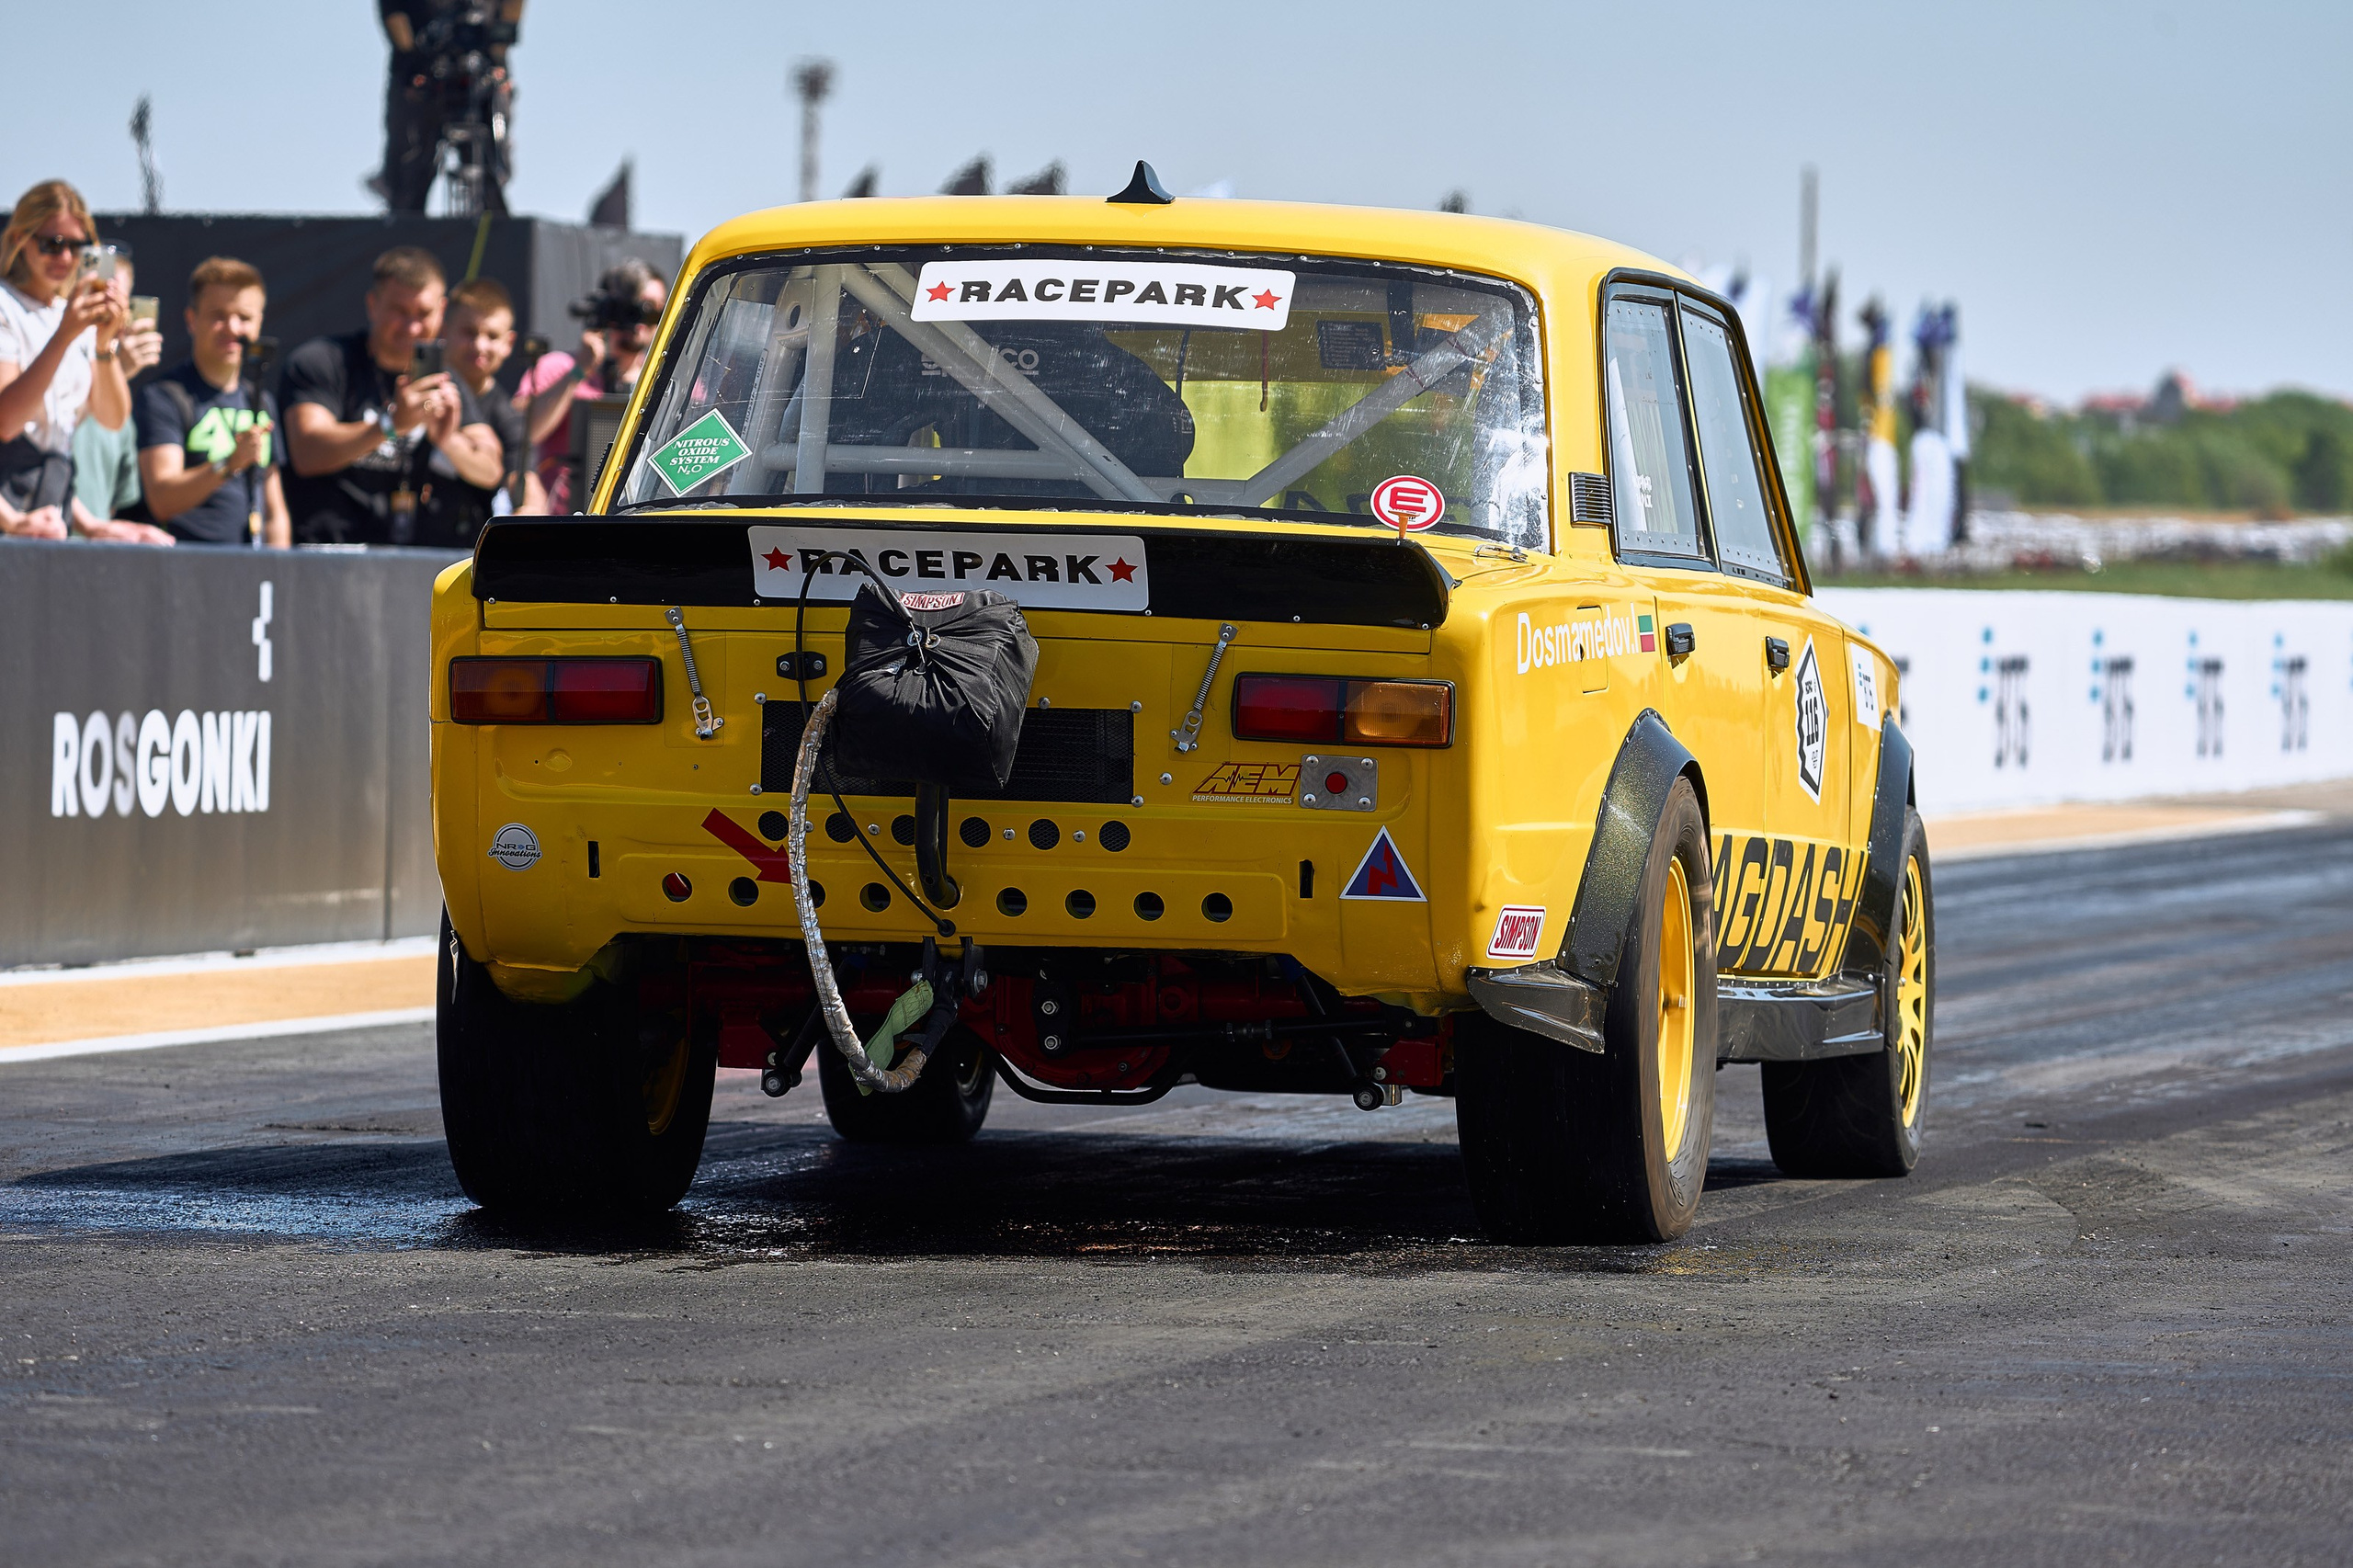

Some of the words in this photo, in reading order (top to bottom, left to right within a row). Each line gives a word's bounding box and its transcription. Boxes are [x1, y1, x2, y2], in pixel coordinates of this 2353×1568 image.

[960, 278, 1249, 310] RACEPARK
[674, 437, 730, 449] NITROUS
[678, 447, 719, 457] OXIDE
[669, 456, 721, 466] SYSTEM
[797, 548, 1103, 585] RACEPARK
[904, 594, 958, 608] SIMPSON
[1805, 696, 1819, 746] 116
[51, 709, 271, 818] ROSGONKI
[1192, 762, 1302, 796] AEM
[1245, 796, 1292, 804] ELECTRONICS
[488, 847, 541, 858] Innovations
[1494, 915, 1541, 950] SIMPSON
